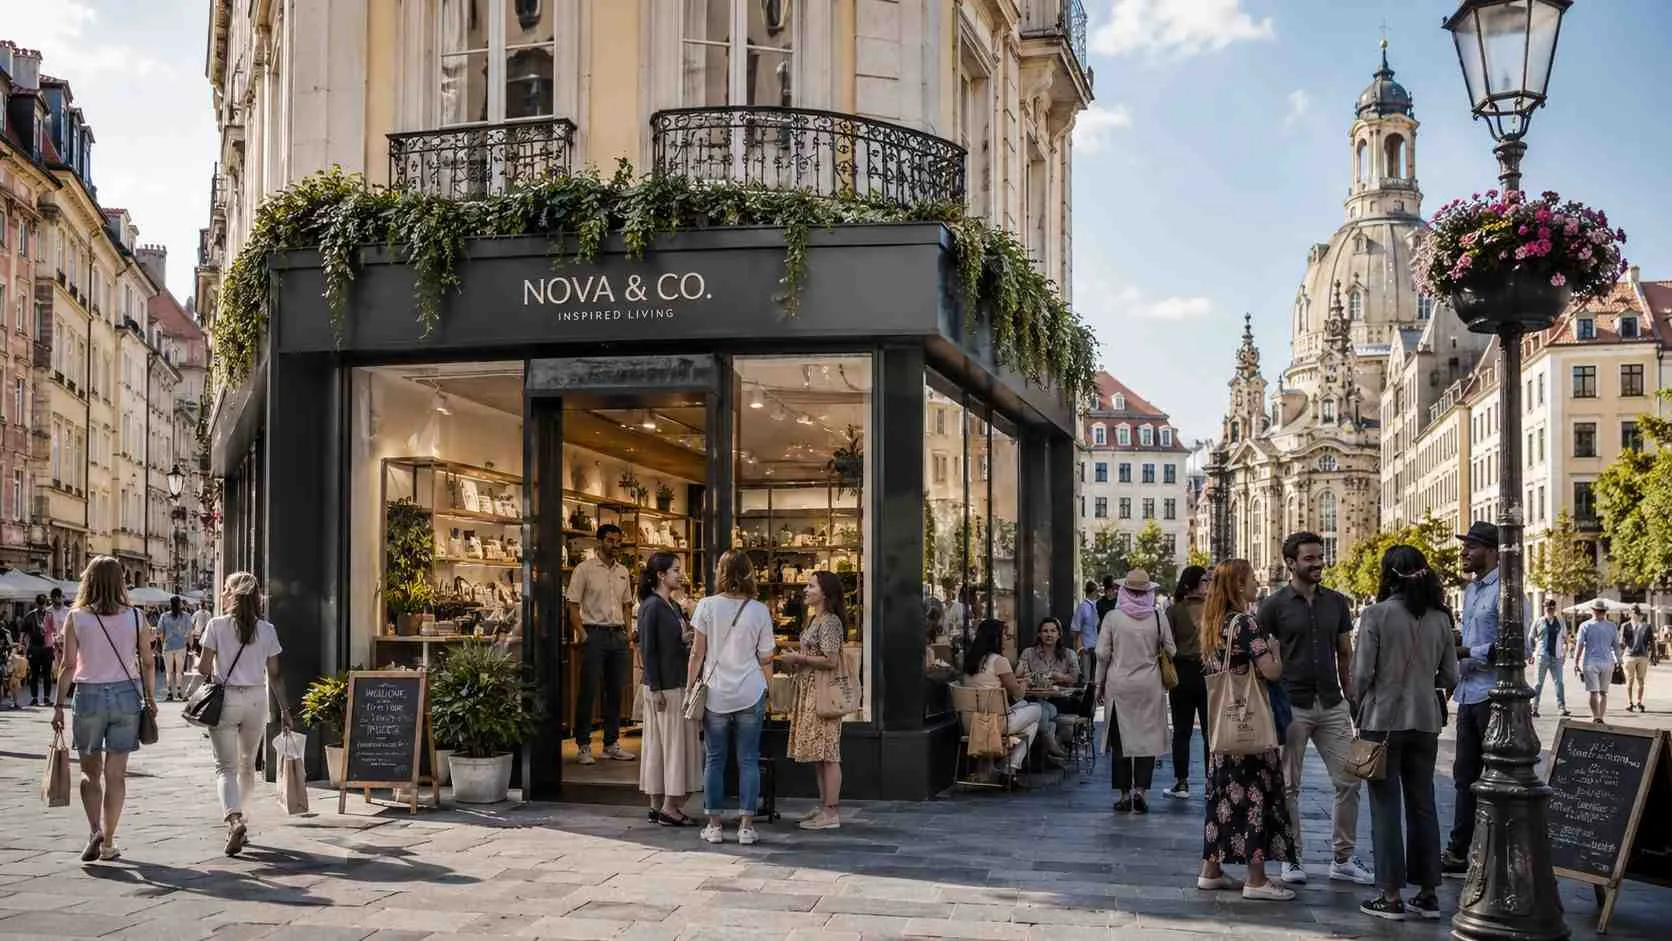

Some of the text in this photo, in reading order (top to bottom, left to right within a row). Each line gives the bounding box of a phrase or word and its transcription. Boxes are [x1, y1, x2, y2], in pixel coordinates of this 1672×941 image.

[524, 272, 712, 305] NOVA & CO.
[558, 308, 674, 321] INSPIRED LIVING
